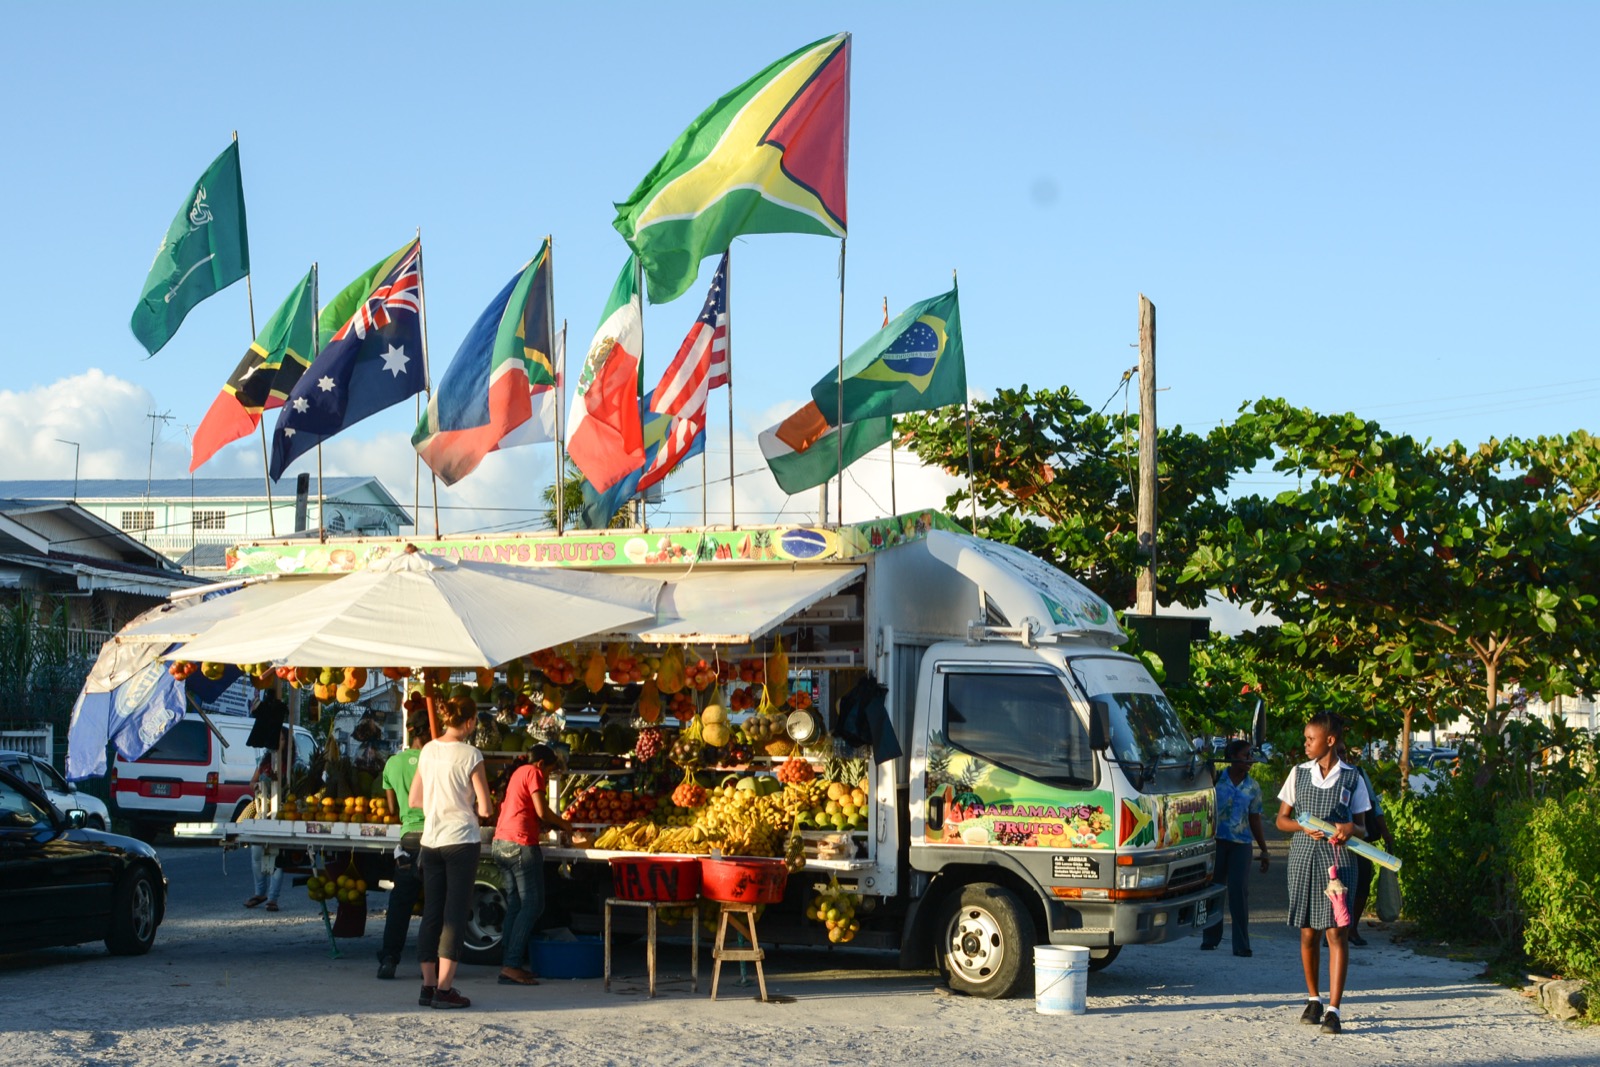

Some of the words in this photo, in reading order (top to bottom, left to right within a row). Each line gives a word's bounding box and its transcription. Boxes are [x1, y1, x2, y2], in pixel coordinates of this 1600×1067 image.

[421, 543, 530, 563] HAMAN'S
[534, 541, 616, 562] FRUITS
[972, 803, 1091, 820] RAHAMAN'S
[993, 821, 1064, 835] FRUITS
